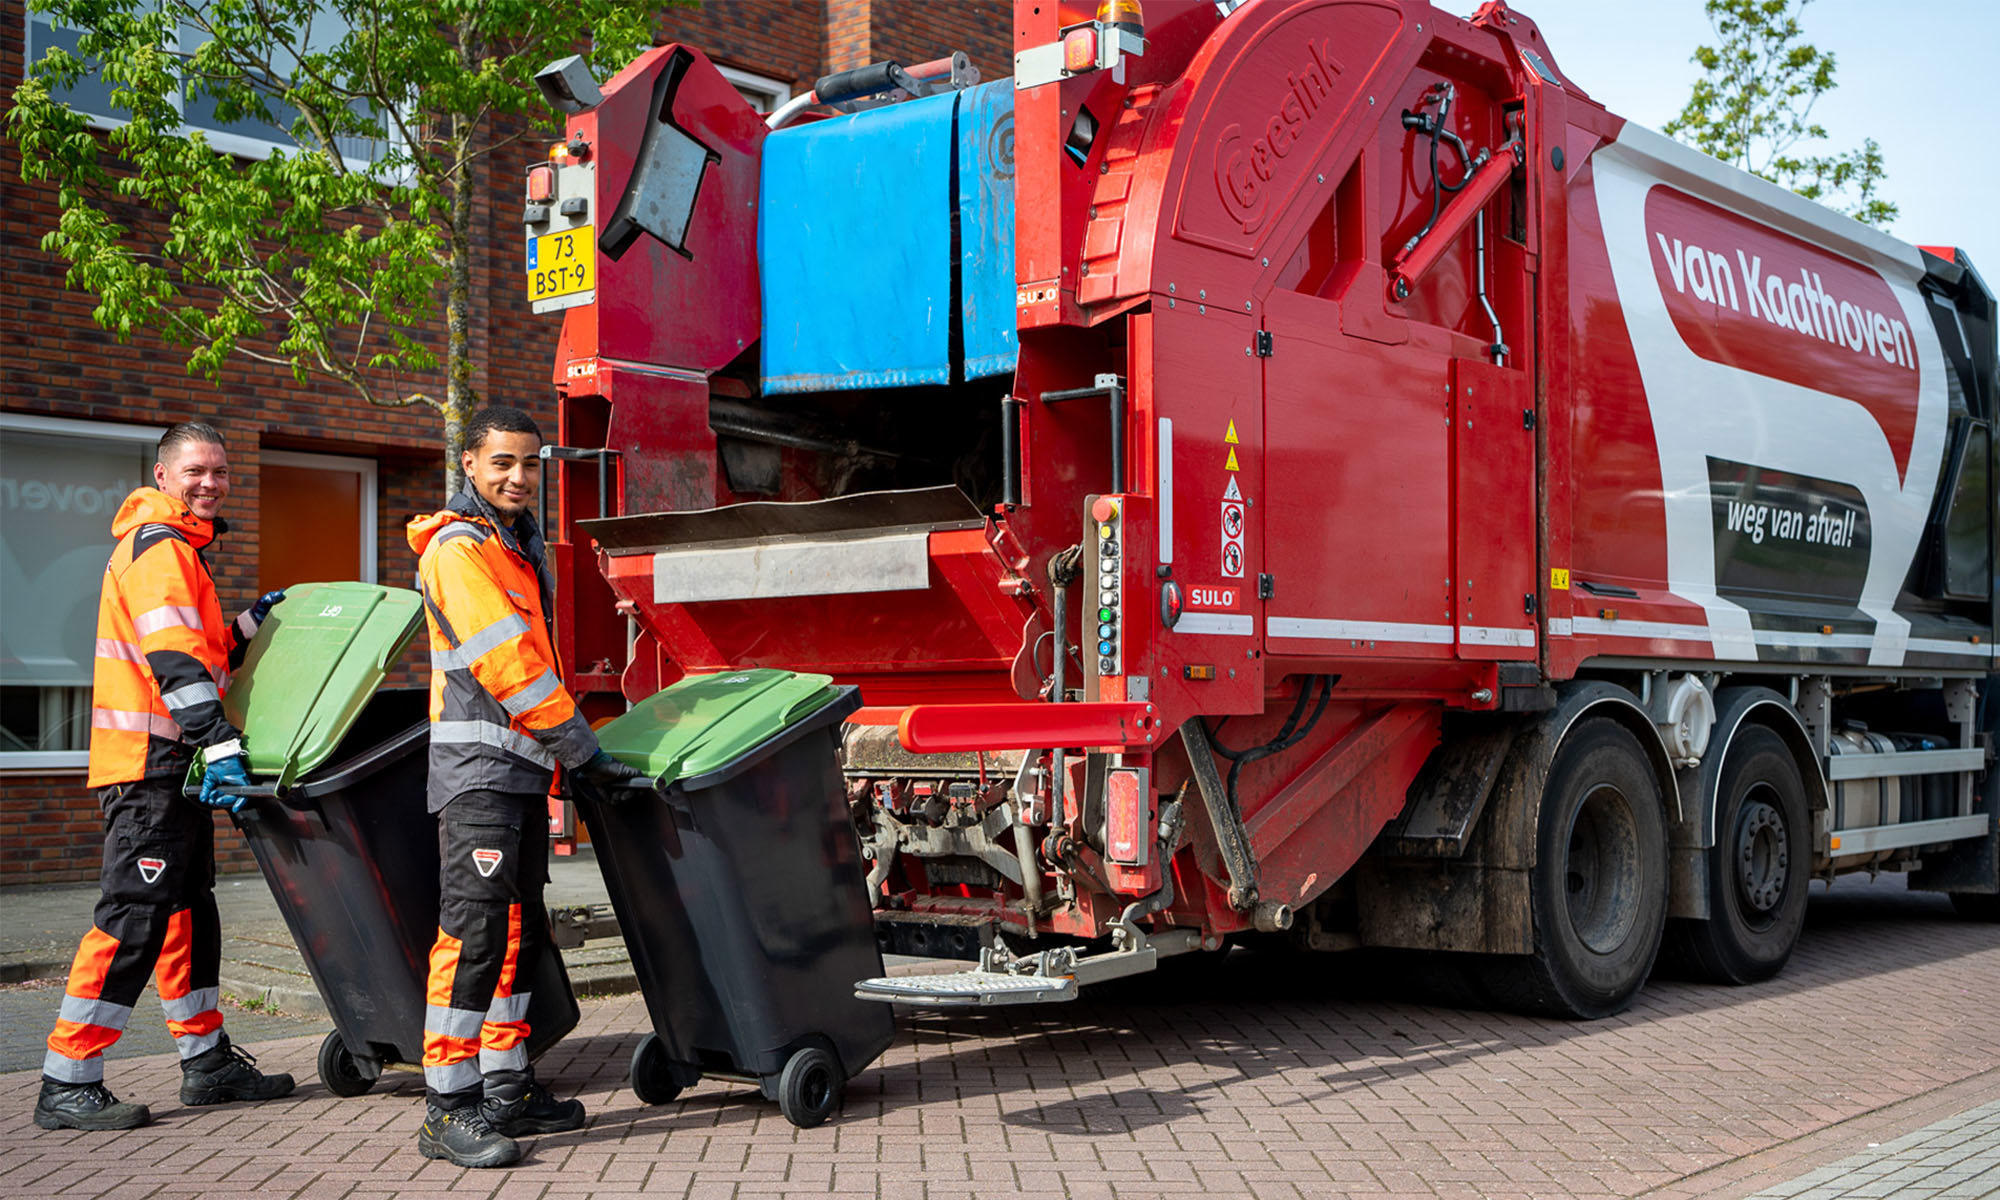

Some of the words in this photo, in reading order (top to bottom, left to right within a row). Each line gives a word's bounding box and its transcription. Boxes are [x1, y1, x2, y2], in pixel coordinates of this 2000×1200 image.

[1214, 38, 1344, 234] Geesink
[554, 234, 574, 260] 73
[536, 264, 585, 295] BST-9
[1655, 232, 1740, 311] van
[1736, 249, 1915, 370] Kaathoven
[1727, 501, 1768, 544] weg
[1771, 508, 1803, 540] van
[1805, 505, 1856, 548] afval!
[1191, 589, 1233, 606] SULO
